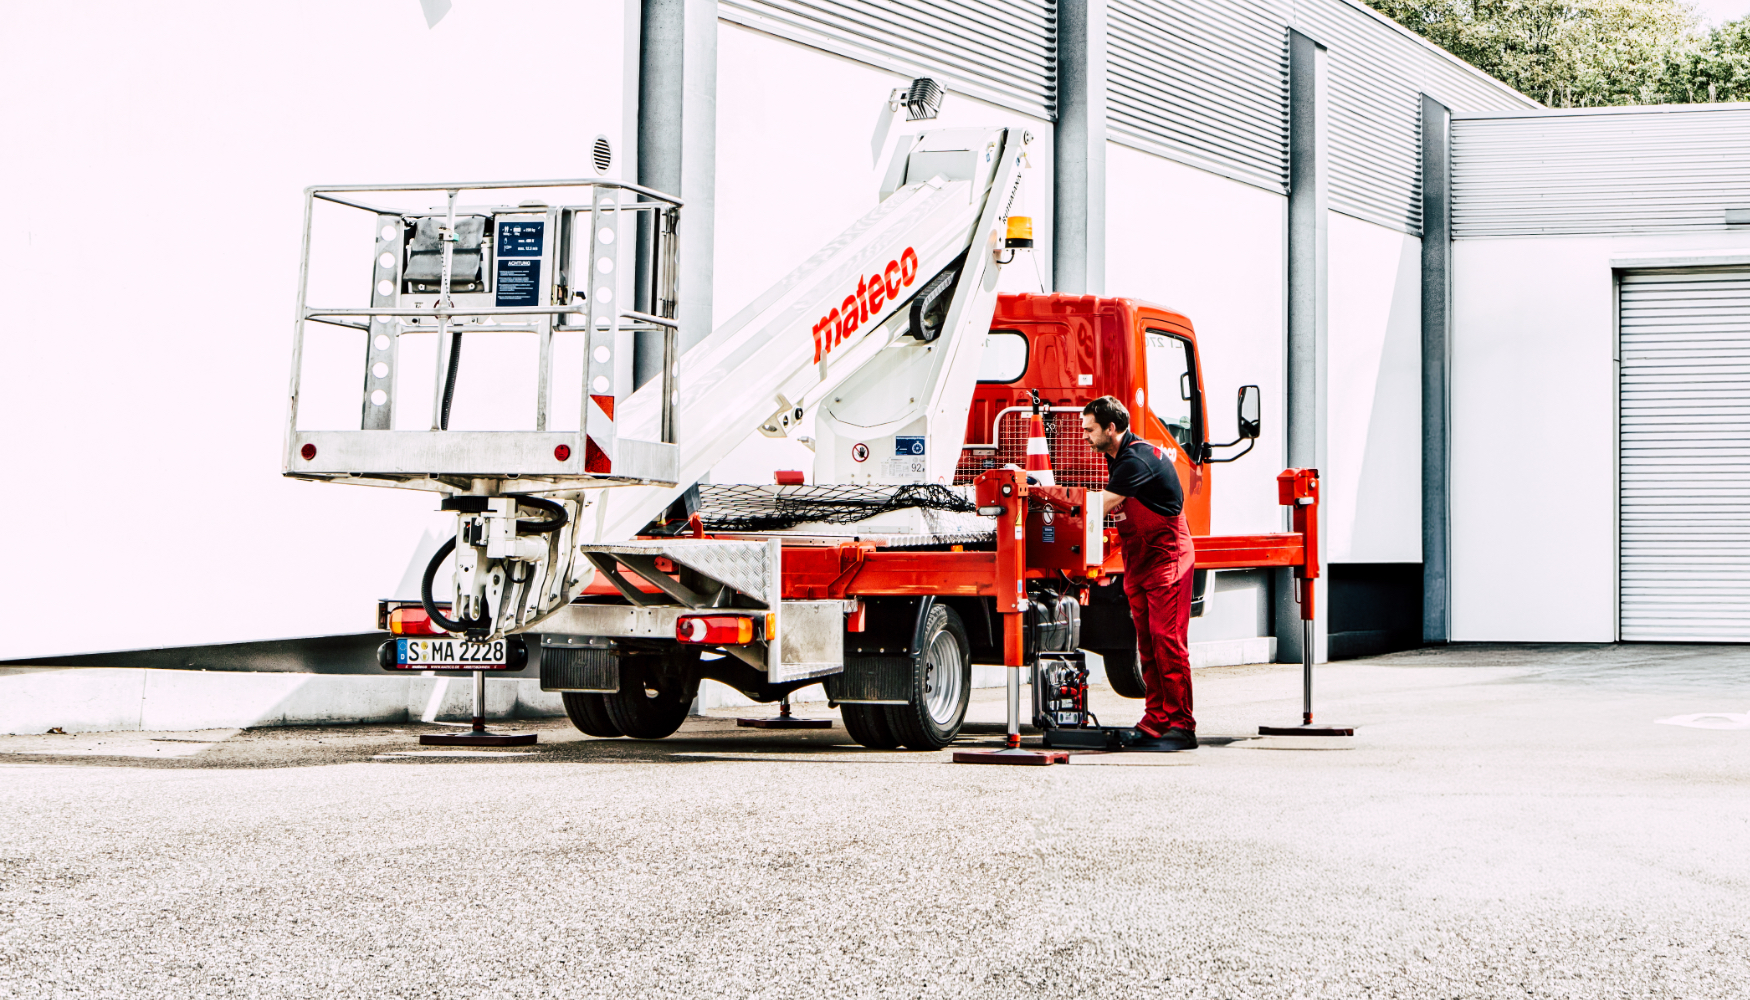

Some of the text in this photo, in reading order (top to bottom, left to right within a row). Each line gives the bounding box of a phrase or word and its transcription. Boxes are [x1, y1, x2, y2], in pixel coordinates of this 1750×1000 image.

[812, 246, 918, 365] mateco
[911, 463, 922, 473] 92
[408, 641, 504, 662] S MA 2228
